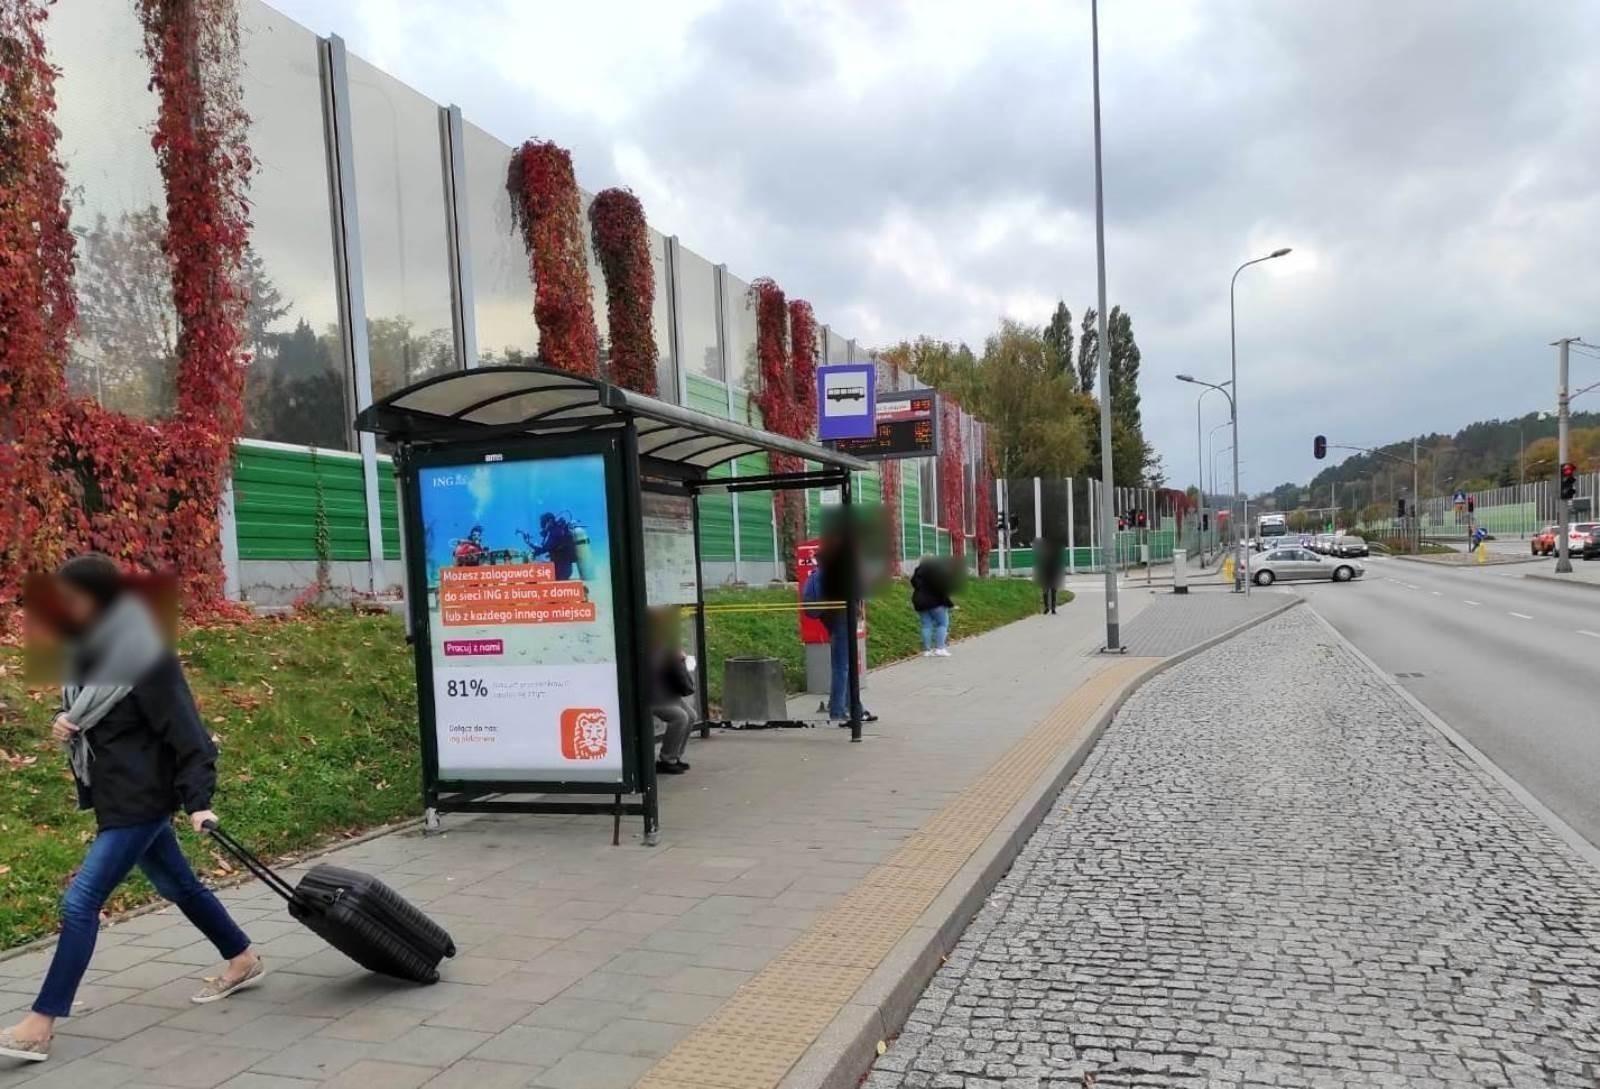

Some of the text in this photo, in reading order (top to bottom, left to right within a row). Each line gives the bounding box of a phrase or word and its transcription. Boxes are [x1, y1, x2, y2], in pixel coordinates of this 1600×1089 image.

[433, 476, 454, 488] ING
[480, 569, 535, 583] zalogować
[537, 566, 552, 579] się
[444, 586, 580, 602] do sieci ING z biura, z domu
[445, 610, 461, 622] lub
[463, 612, 469, 621] z
[514, 608, 549, 622] innego
[552, 606, 592, 621] miejsca
[447, 643, 472, 654] Pracuj
[479, 642, 501, 651] nami
[447, 679, 488, 697] 81%
[474, 724, 483, 732] do
